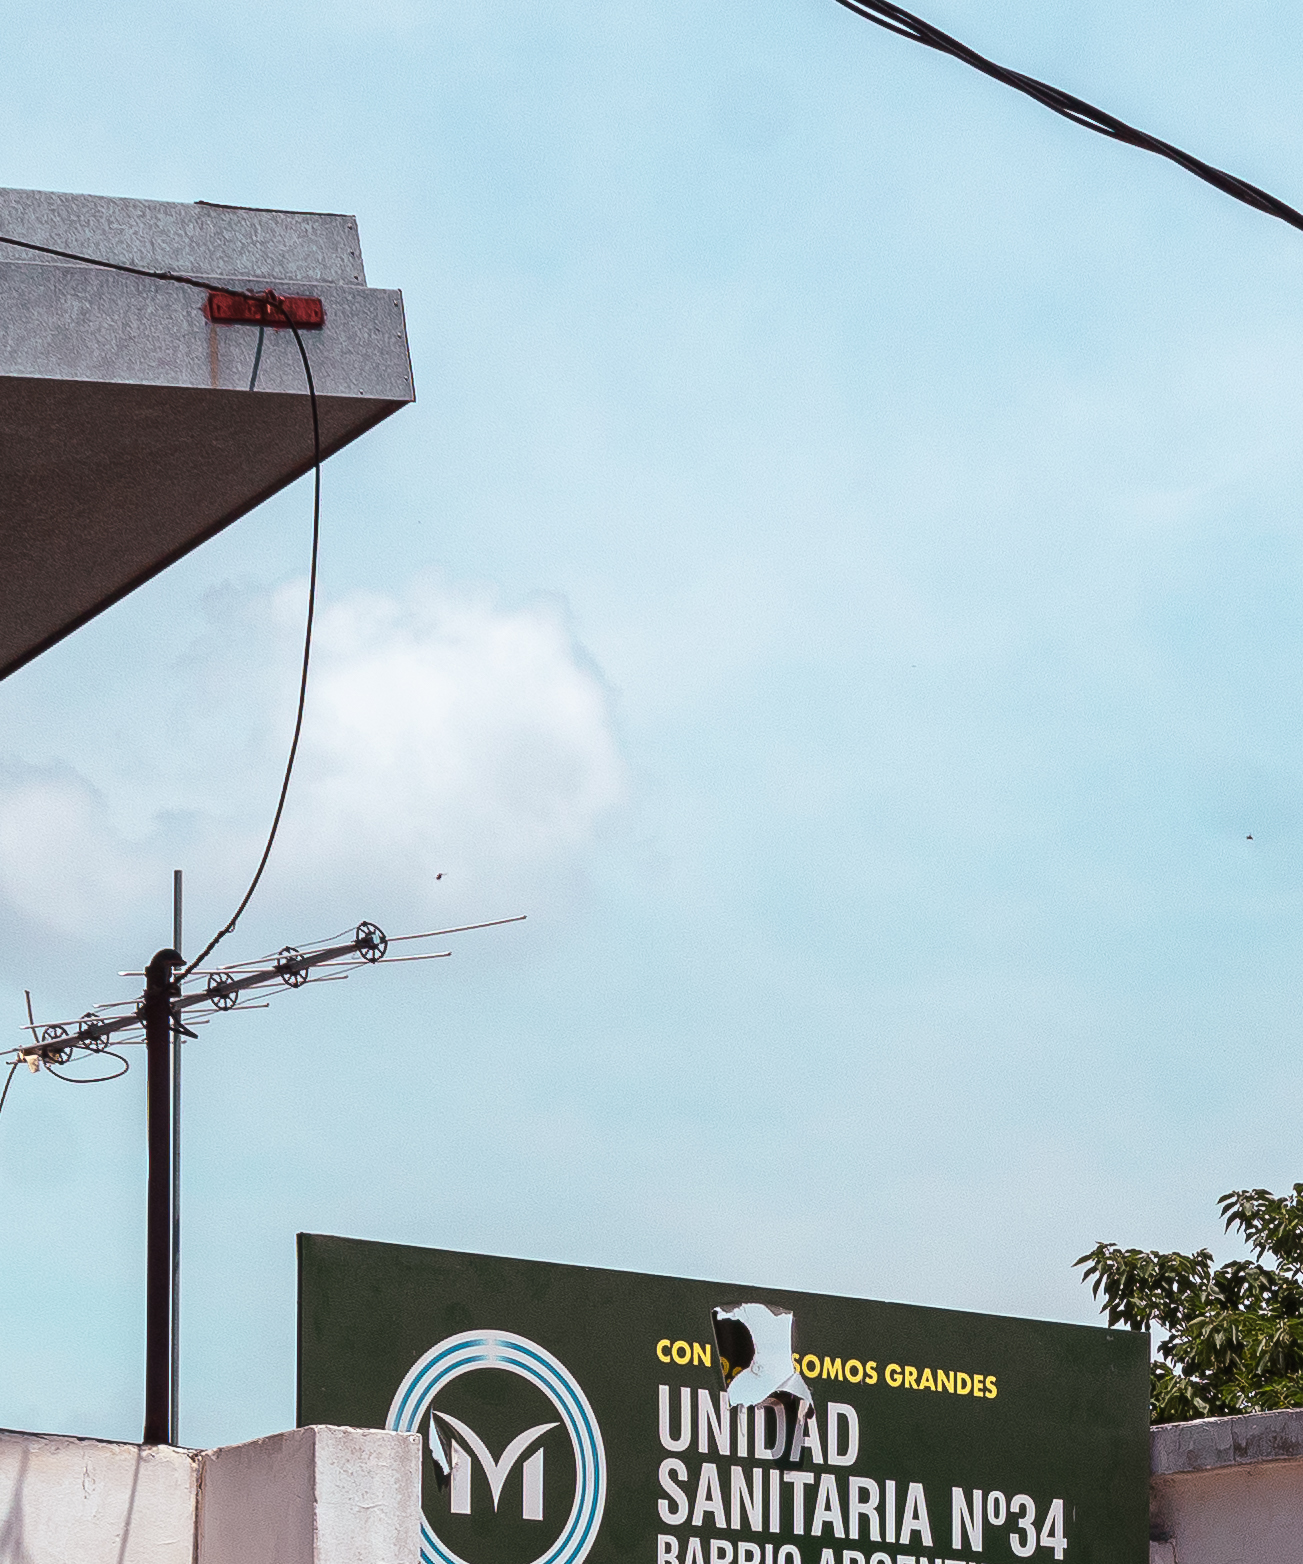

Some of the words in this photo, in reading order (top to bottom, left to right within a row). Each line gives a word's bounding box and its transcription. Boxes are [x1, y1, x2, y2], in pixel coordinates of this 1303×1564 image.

[656, 1338, 712, 1368] CON
[791, 1352, 879, 1385] SOMOS
[884, 1362, 999, 1399] GRANDES
[657, 1384, 861, 1467] UNIDAD
[657, 1458, 934, 1548] SANITARIA
[951, 1486, 1069, 1561] Nº34
